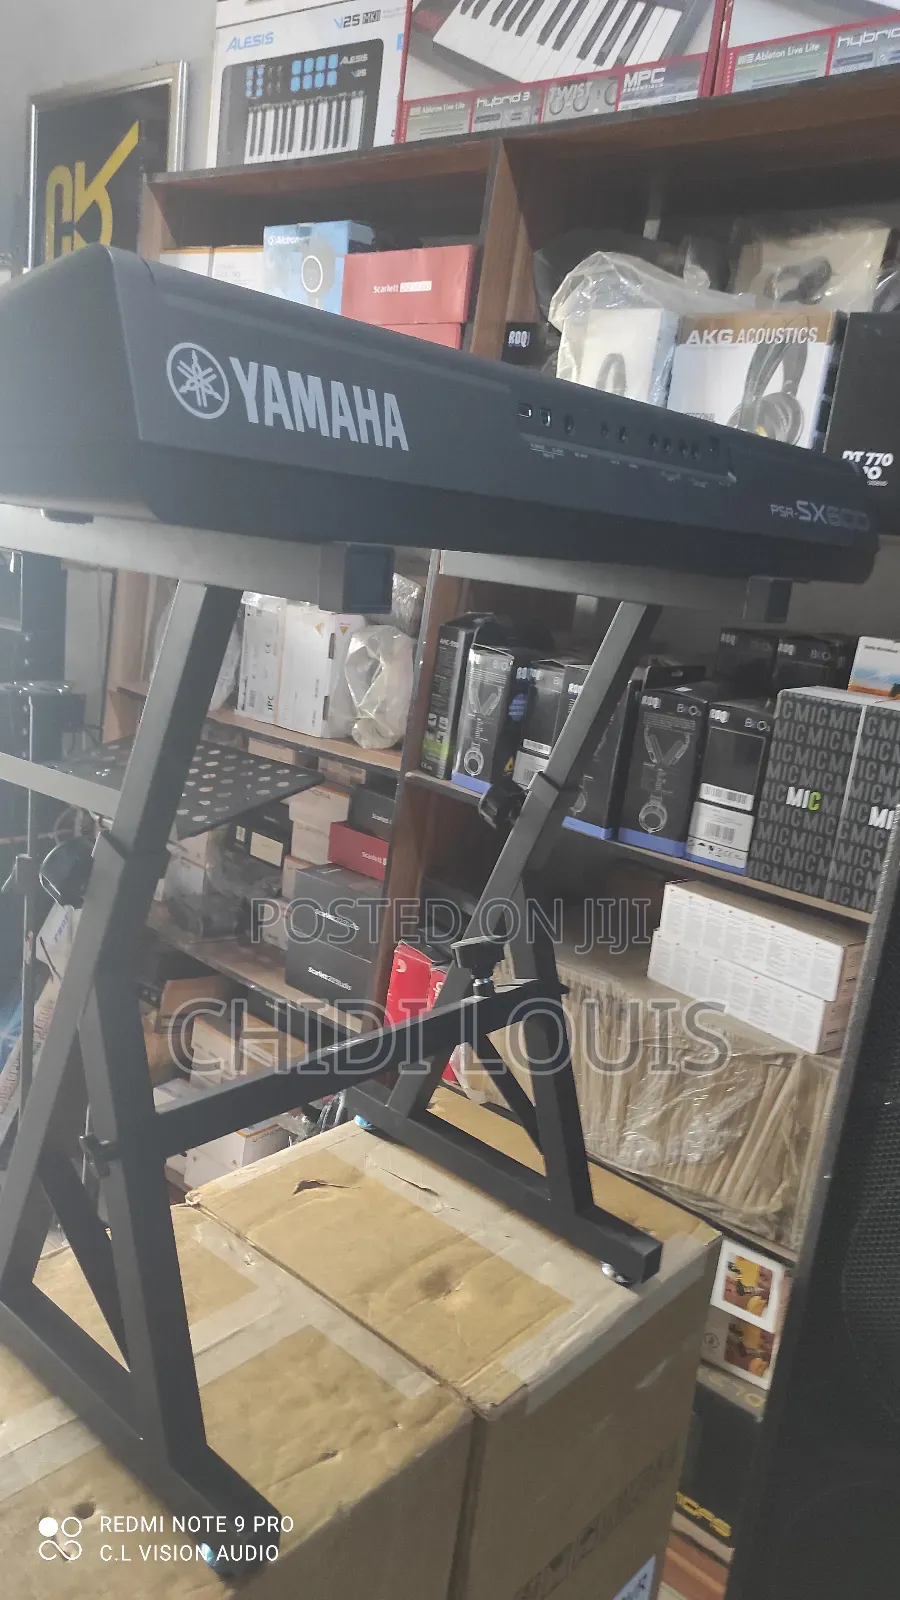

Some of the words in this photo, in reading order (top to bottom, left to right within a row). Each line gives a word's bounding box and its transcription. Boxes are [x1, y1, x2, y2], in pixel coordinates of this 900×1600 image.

[334, 14, 361, 29] V25
[226, 31, 275, 52] ALESIS
[340, 53, 369, 66] ALESIS
[754, 50, 786, 62] Ableton
[787, 45, 803, 57] Live
[805, 43, 820, 52] Lite
[624, 67, 666, 88] MPC
[372, 284, 399, 294] Scarlett
[686, 329, 735, 345] AKG
[736, 327, 818, 345] ACOUSTICS
[229, 356, 410, 452] YAMAHA
[865, 452, 894, 467] 770
[786, 786, 821, 811] MIC
